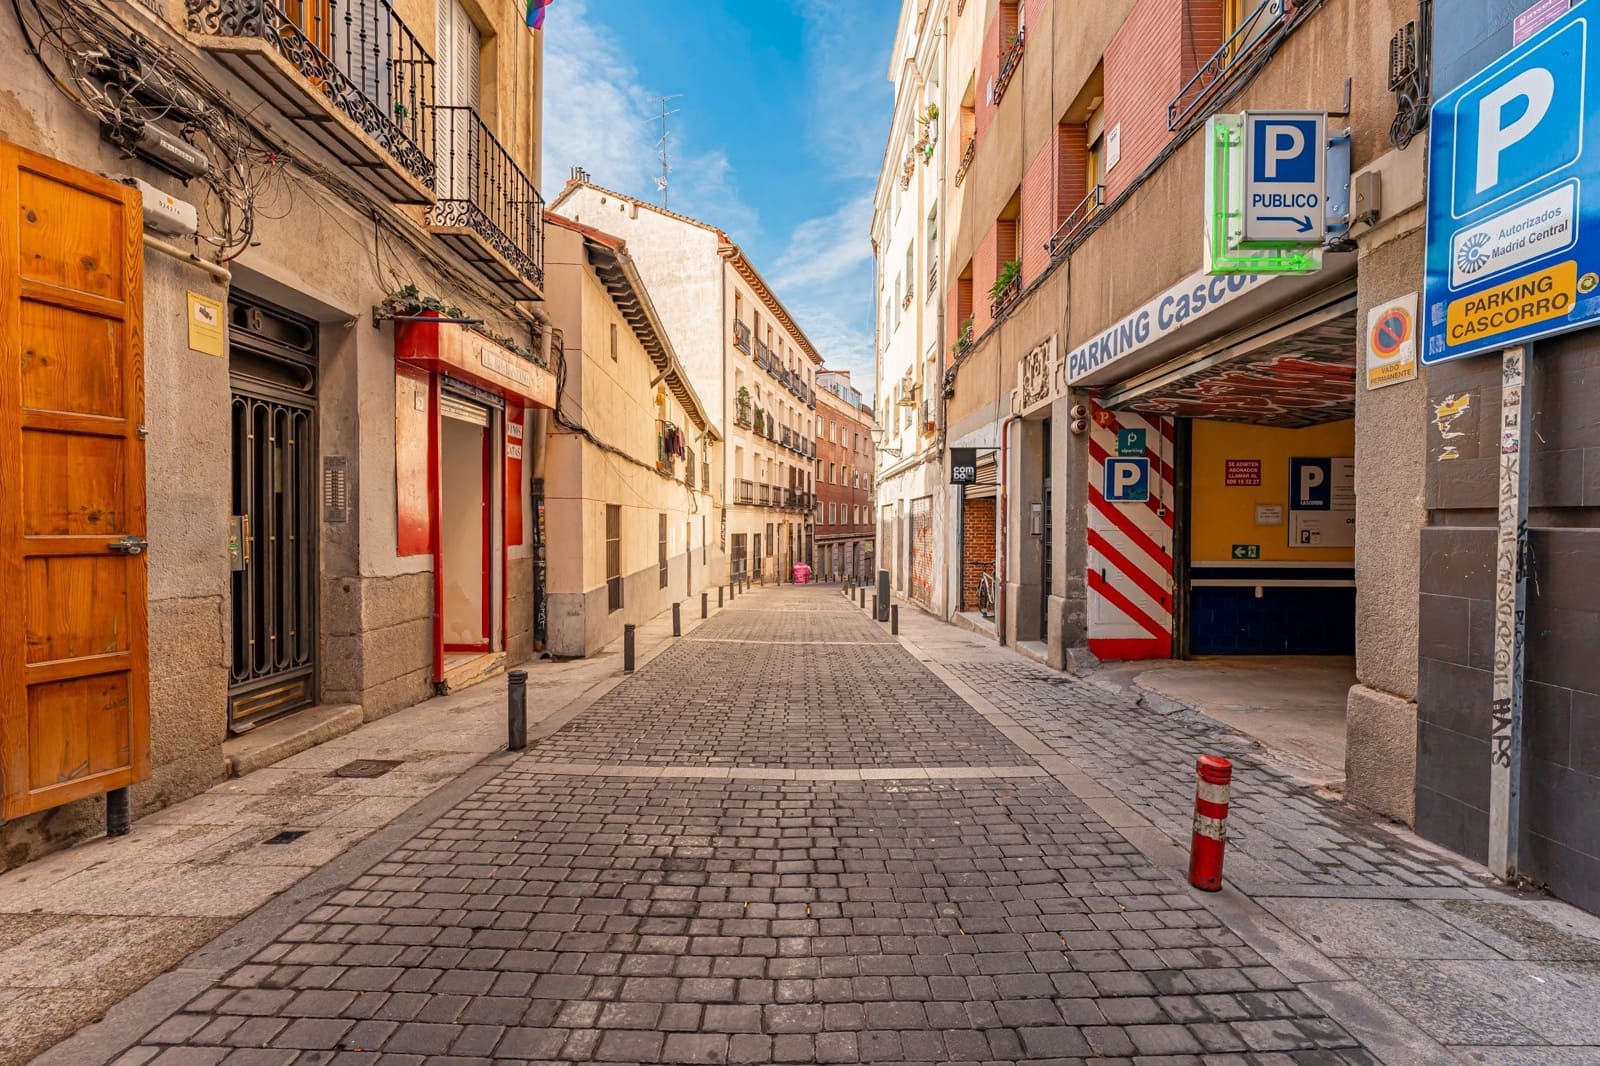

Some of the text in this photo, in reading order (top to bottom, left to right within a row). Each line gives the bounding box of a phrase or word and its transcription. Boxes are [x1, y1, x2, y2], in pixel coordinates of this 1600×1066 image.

[1476, 67, 1555, 195] P
[1264, 125, 1305, 178] P
[1252, 193, 1318, 209] PUBLICO
[1491, 219, 1569, 259] Madrid Central
[1498, 206, 1562, 241] Autorizados
[1451, 292, 1569, 339] CASCORRO
[1464, 275, 1553, 318] PARKING
[1069, 311, 1150, 380] PARKING
[1381, 364, 1400, 374] VADO
[1114, 463, 1141, 497] P
[1300, 465, 1324, 501] P
